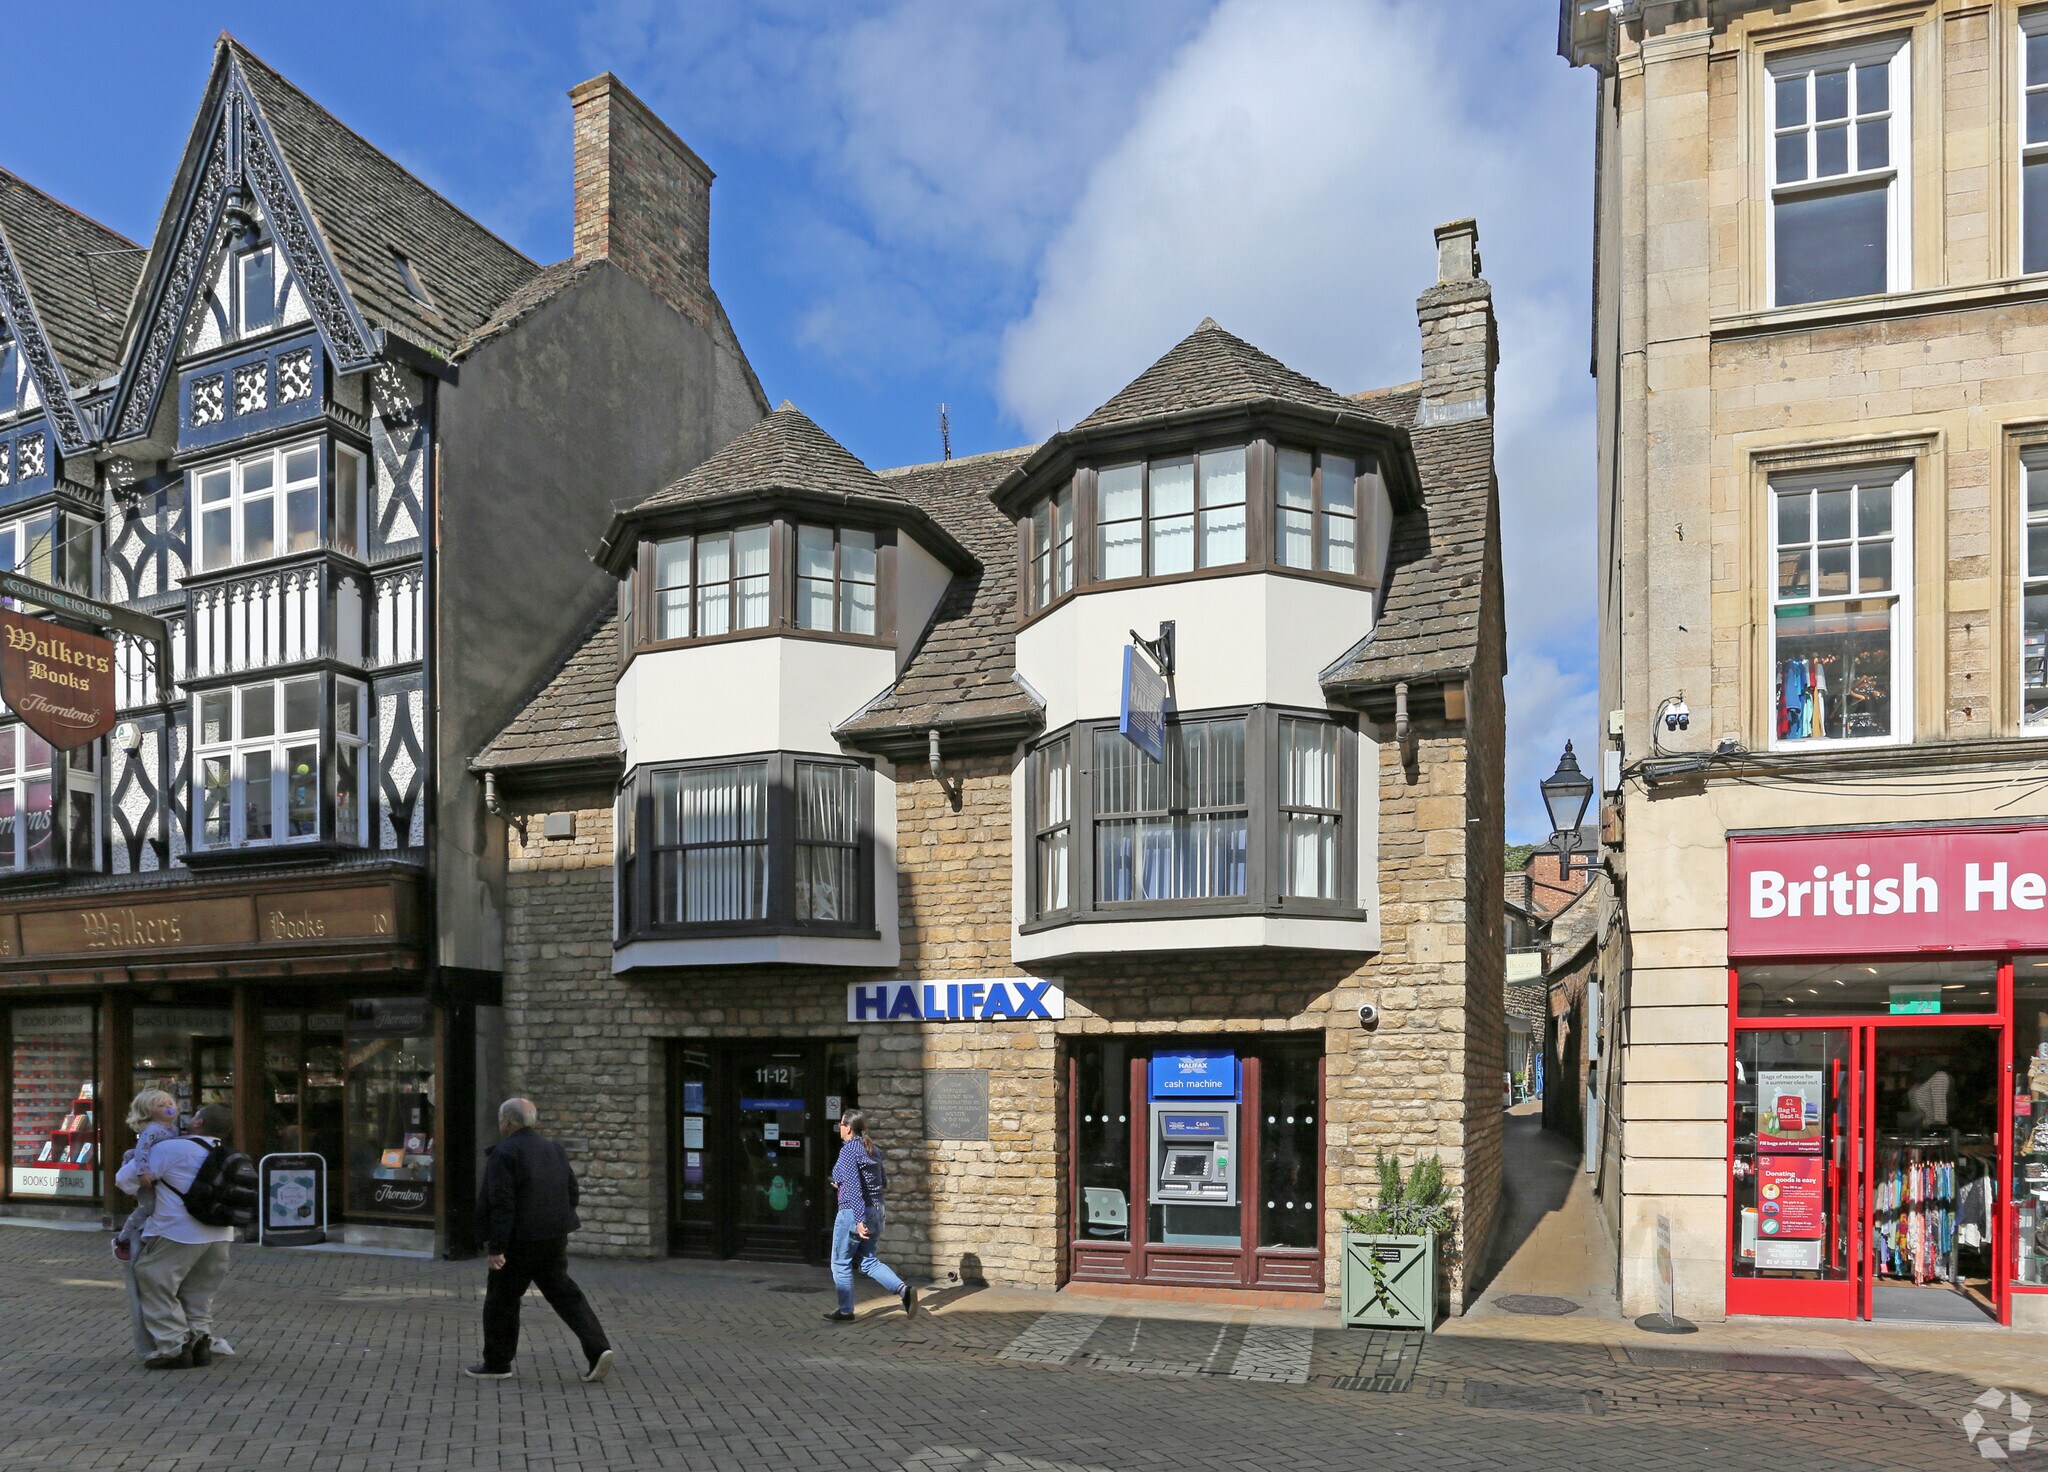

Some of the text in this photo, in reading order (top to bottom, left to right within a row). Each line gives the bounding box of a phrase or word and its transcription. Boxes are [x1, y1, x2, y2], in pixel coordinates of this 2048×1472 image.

[10, 580, 110, 620] GOTHIC HOUSE
[5, 625, 109, 673] Walkers
[28, 660, 90, 691] Books
[20, 694, 97, 725] Thorntons
[1131, 682, 1164, 730] HALIFAX
[1750, 862, 1938, 918] British
[81, 909, 181, 946] Walkers
[270, 909, 325, 938] Books
[856, 982, 1052, 1020] HALIFAX
[22, 1014, 83, 1027] BOOKS UPSTAIRS
[374, 1010, 424, 1030] Thorntons
[756, 1069, 788, 1083] 11-12
[1164, 1079, 1222, 1088] cash machine
[22, 1176, 84, 1188] BOOKS UPSTAIRS
[1766, 1170, 1795, 1178] Donating
[375, 1184, 426, 1204] Thorntons
